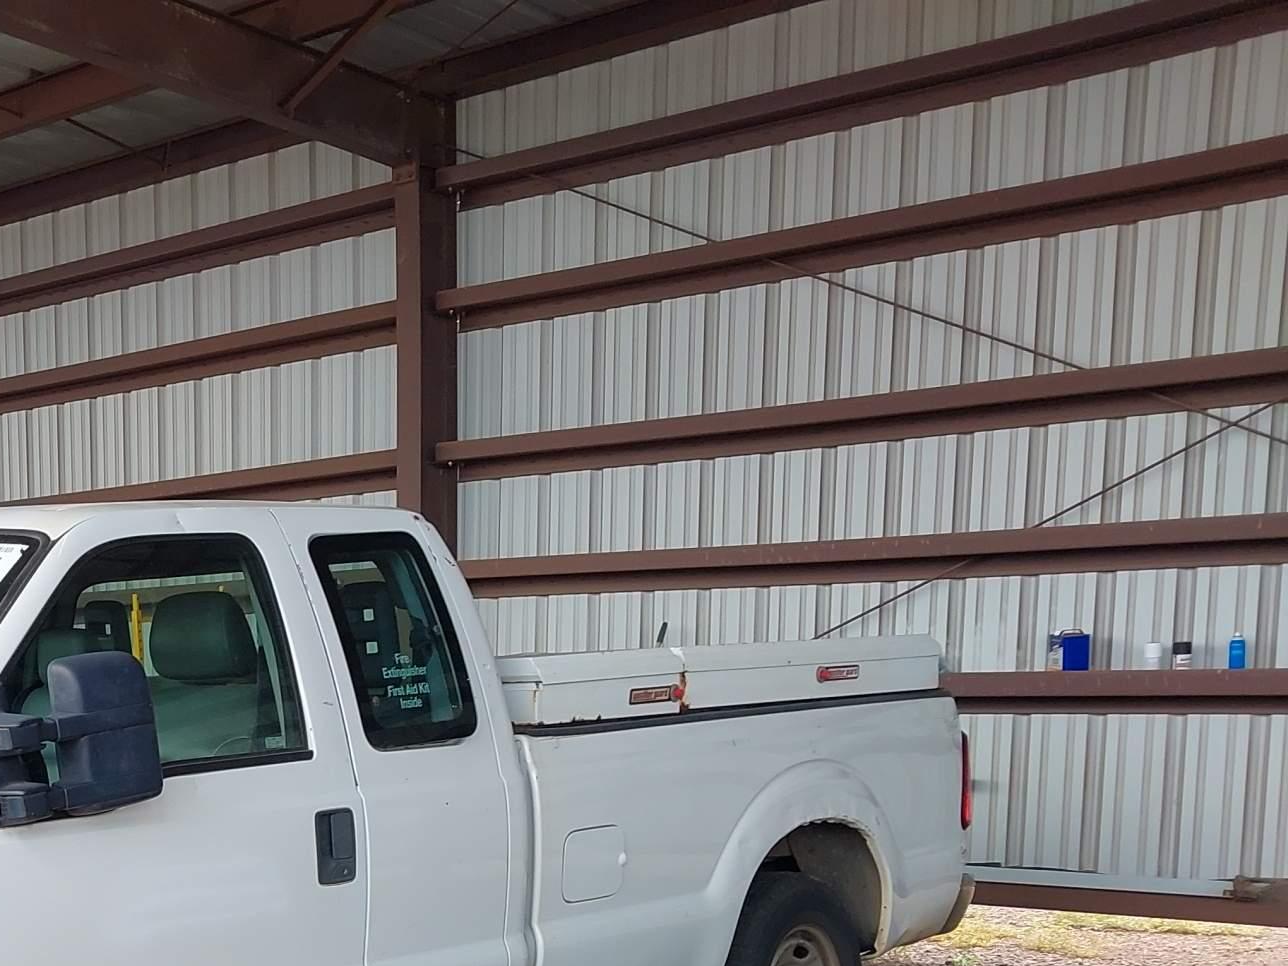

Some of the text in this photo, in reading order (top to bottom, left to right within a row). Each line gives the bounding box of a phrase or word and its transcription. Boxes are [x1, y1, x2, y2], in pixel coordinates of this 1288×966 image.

[394, 653, 410, 664] Fire
[382, 665, 427, 679] Extinguisher
[387, 682, 430, 697] First Aid Kit
[400, 697, 423, 709] Inside
